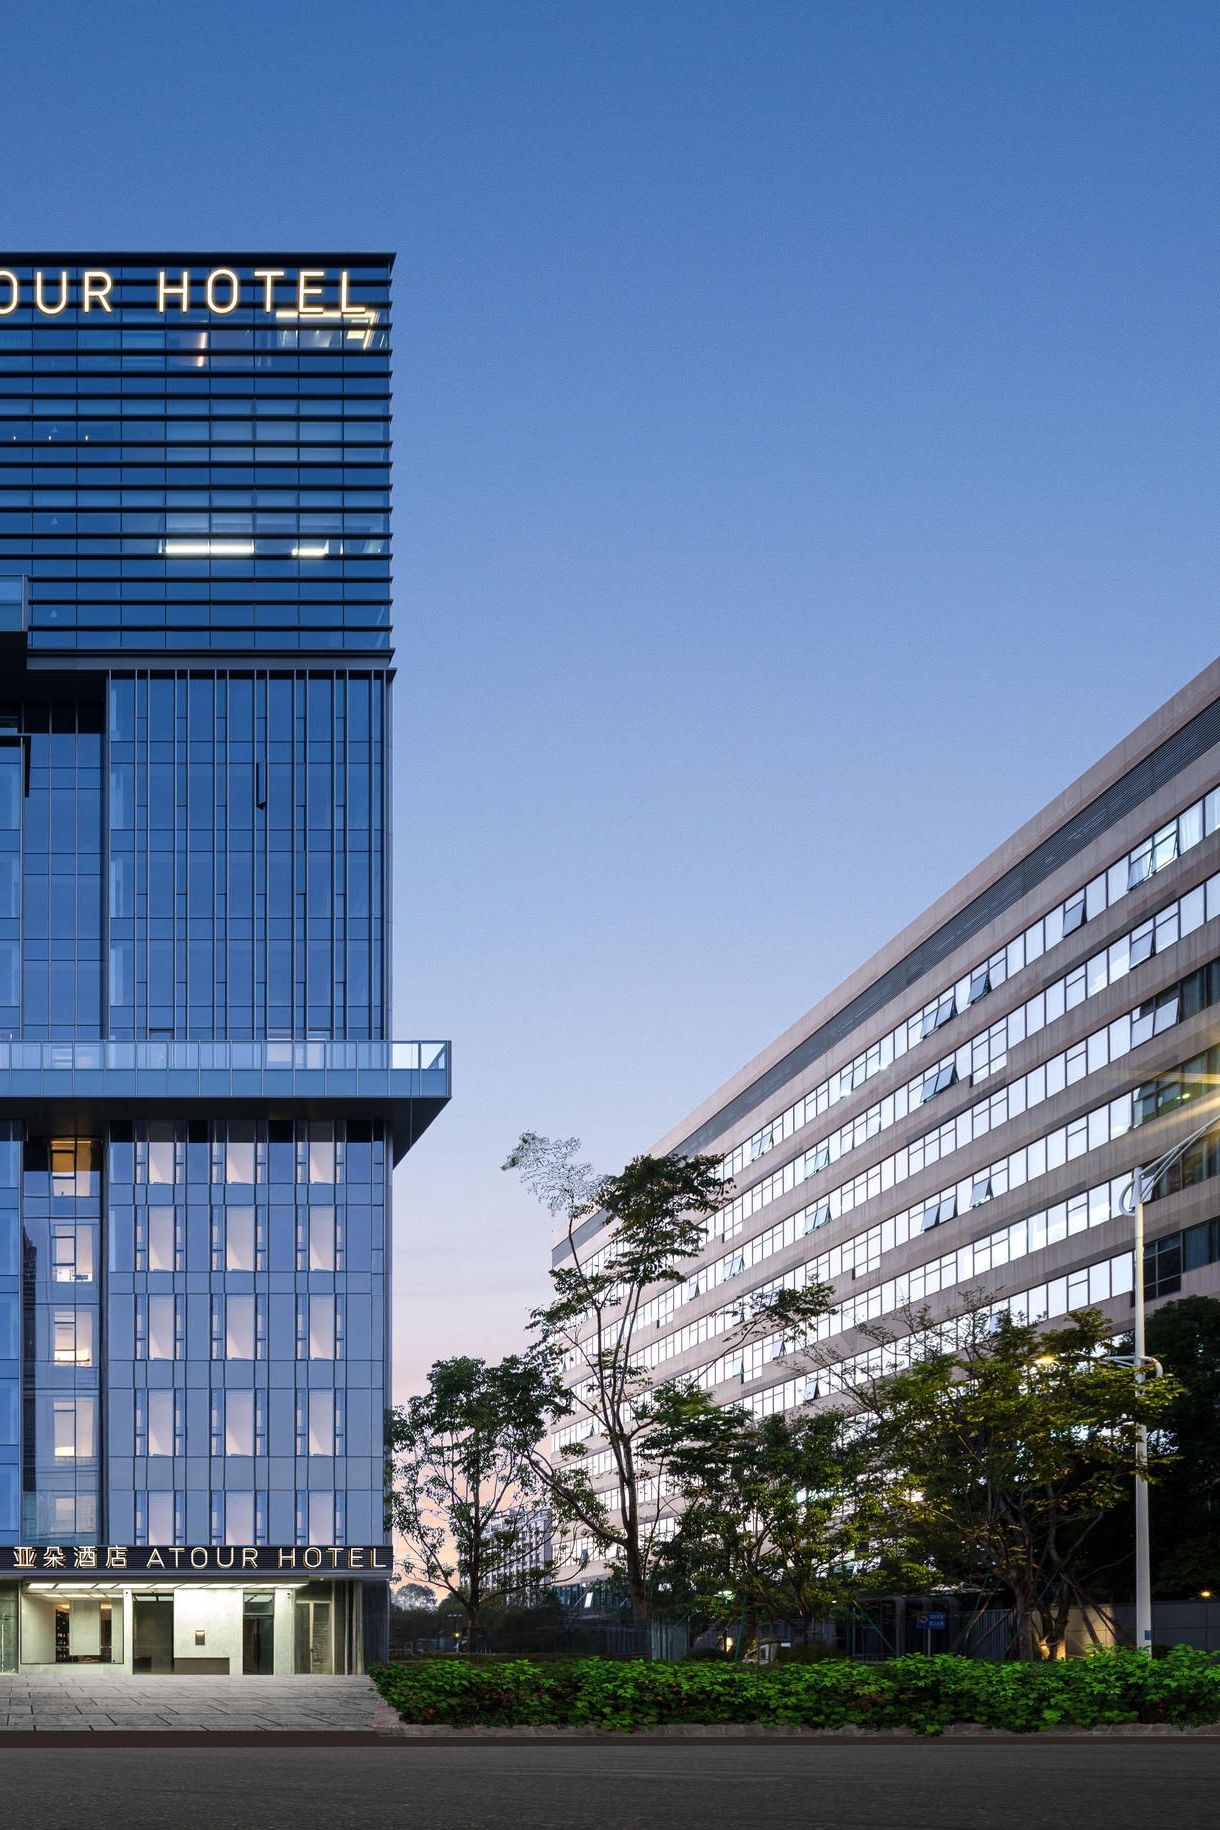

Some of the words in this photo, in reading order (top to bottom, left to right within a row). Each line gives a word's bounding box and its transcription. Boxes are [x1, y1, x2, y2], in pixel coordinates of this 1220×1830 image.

[159, 269, 367, 315] HOTEL
[13, 1545, 128, 1568] 亚朵酒店
[146, 1547, 259, 1568] ATOUR
[278, 1547, 387, 1568] HOTEL
